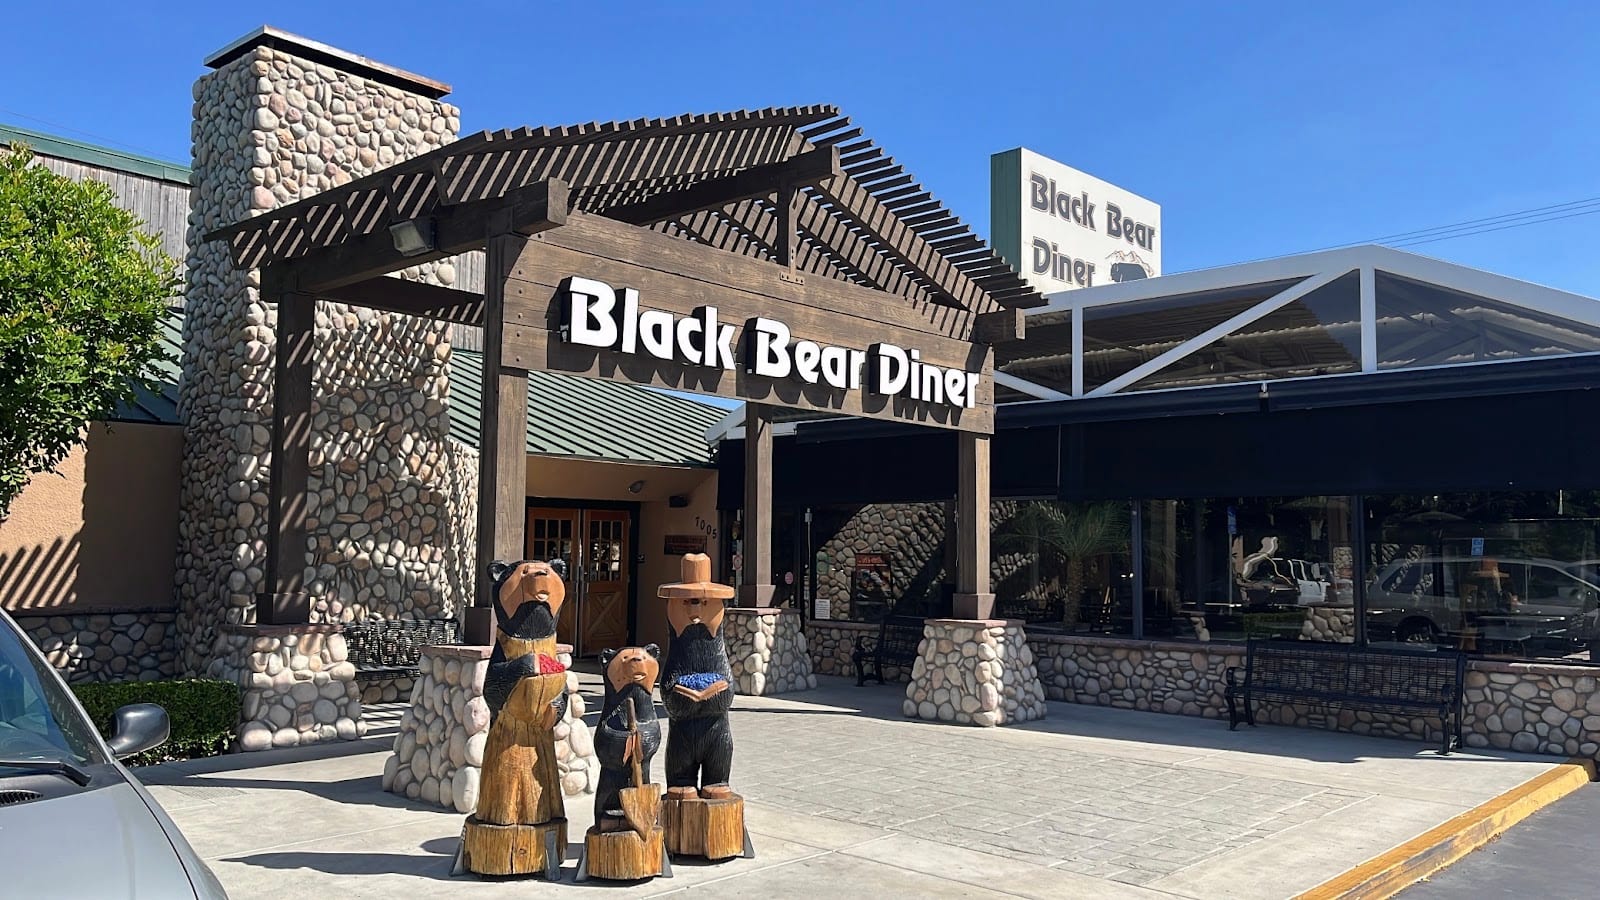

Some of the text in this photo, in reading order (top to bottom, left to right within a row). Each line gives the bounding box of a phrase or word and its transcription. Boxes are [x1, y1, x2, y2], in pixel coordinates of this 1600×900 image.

[1030, 171, 1155, 252] Black Bear
[1032, 236, 1096, 288] Diner
[568, 275, 980, 408] Black Bear Diner
[695, 516, 717, 540] 7005
